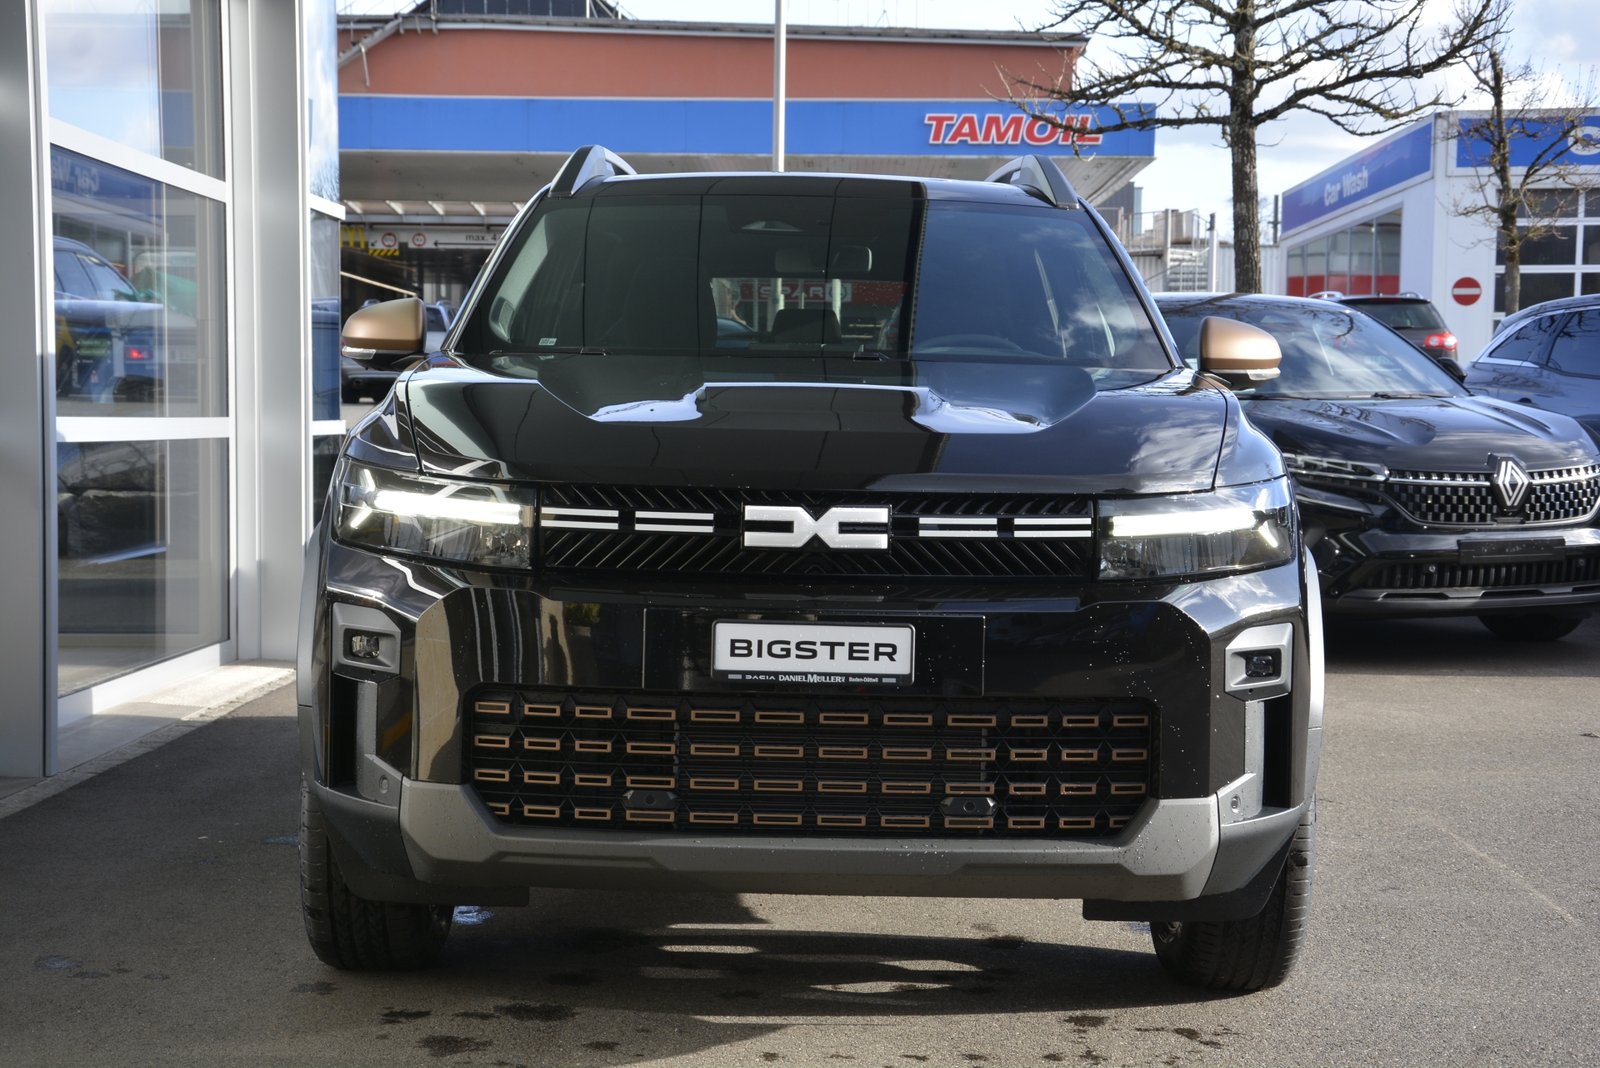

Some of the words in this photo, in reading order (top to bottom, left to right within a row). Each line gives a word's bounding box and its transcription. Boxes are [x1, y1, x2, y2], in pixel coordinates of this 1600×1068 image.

[925, 113, 1104, 145] TAMOIL
[1324, 183, 1341, 207] Car
[1342, 165, 1368, 198] Wash
[759, 286, 824, 298] SPAR
[729, 638, 898, 662] BIGSTER
